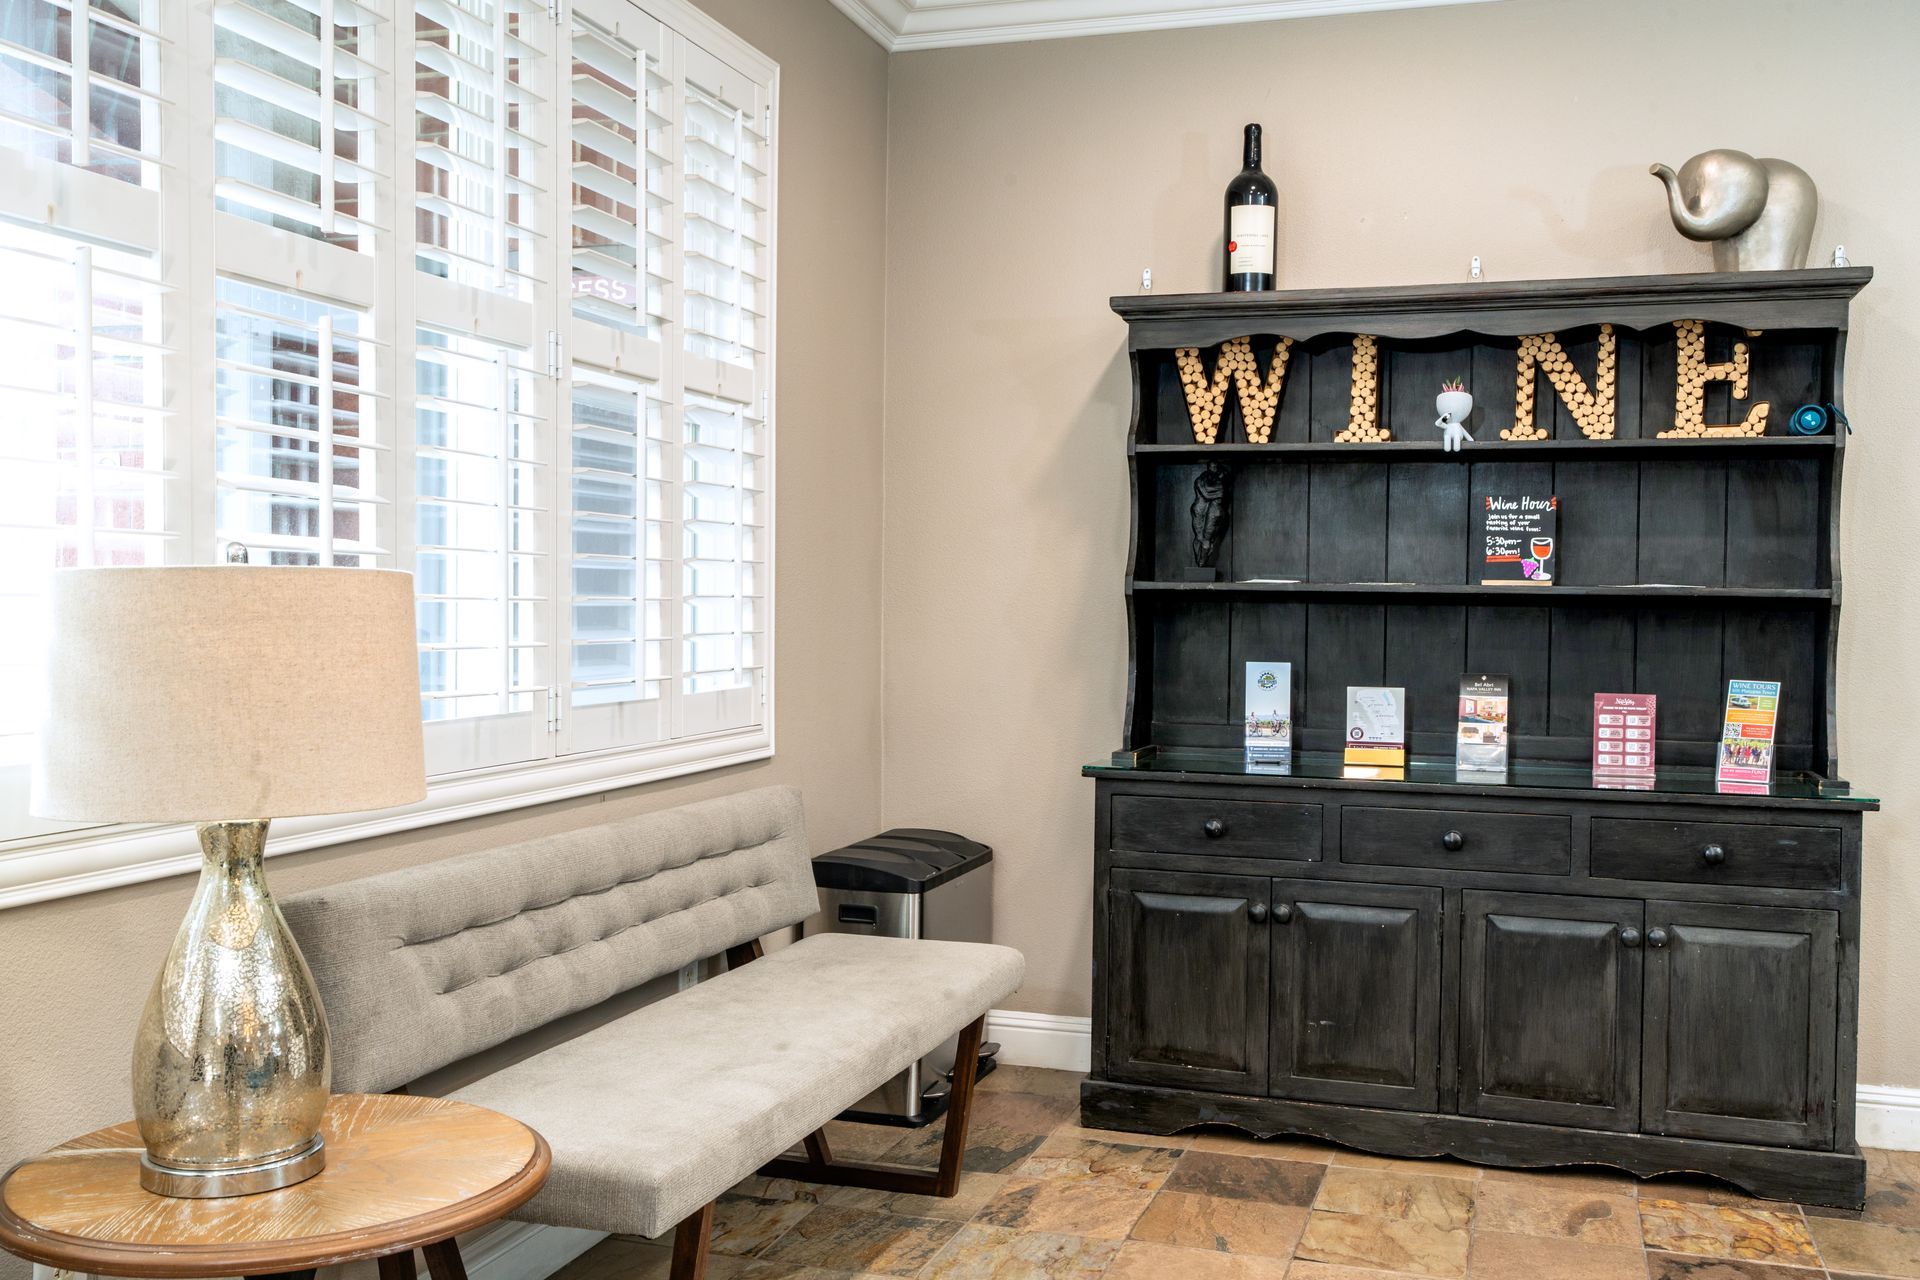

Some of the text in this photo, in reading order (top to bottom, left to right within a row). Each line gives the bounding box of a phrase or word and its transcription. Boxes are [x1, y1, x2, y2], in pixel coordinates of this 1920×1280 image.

[1175, 319, 1770, 440] WINE
[1489, 495, 1554, 512] Wine Hour
[1486, 546, 1521, 556] 6:30pm!
[1753, 683, 1777, 691] TOURS
